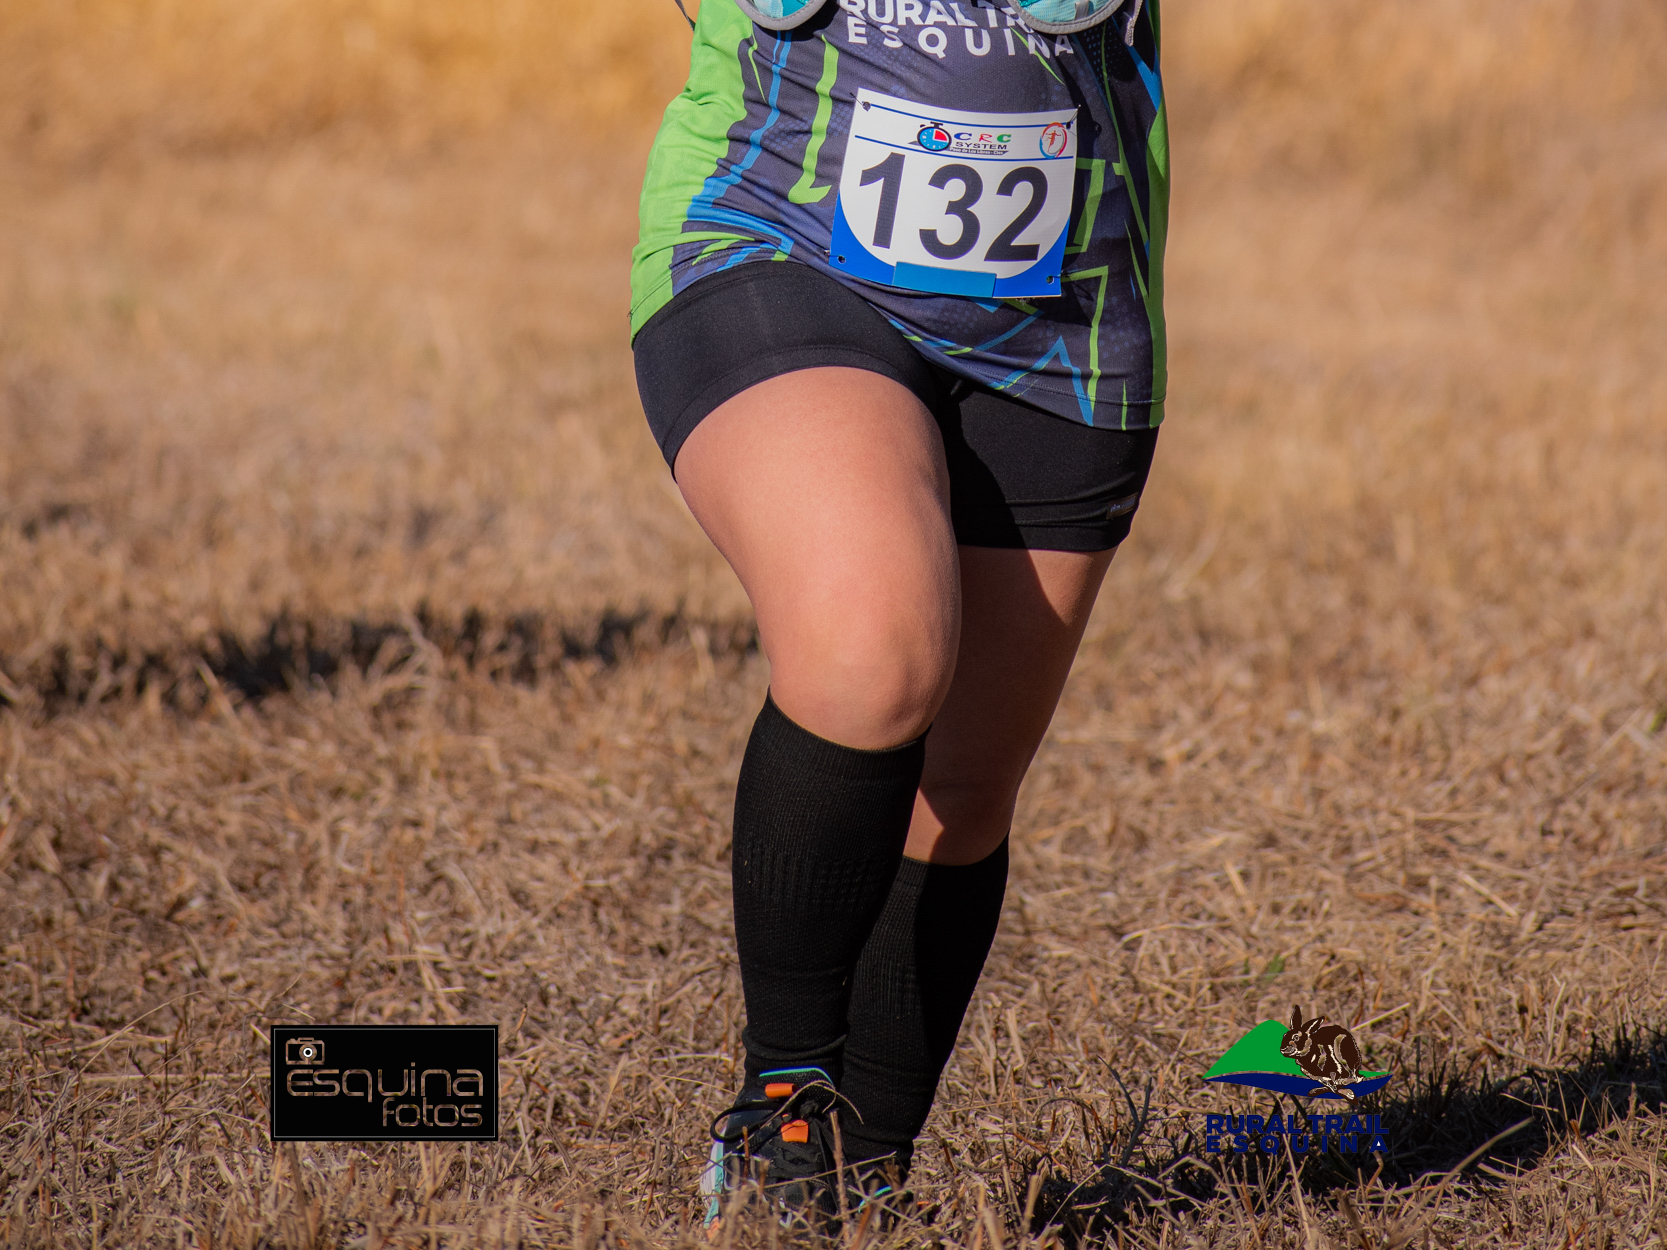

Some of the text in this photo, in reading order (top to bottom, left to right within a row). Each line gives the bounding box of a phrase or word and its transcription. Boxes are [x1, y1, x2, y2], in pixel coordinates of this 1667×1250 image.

[847, 14, 1074, 59] ESQUINA
[956, 142, 1007, 150] SYSTEM
[859, 151, 1049, 262] 132
